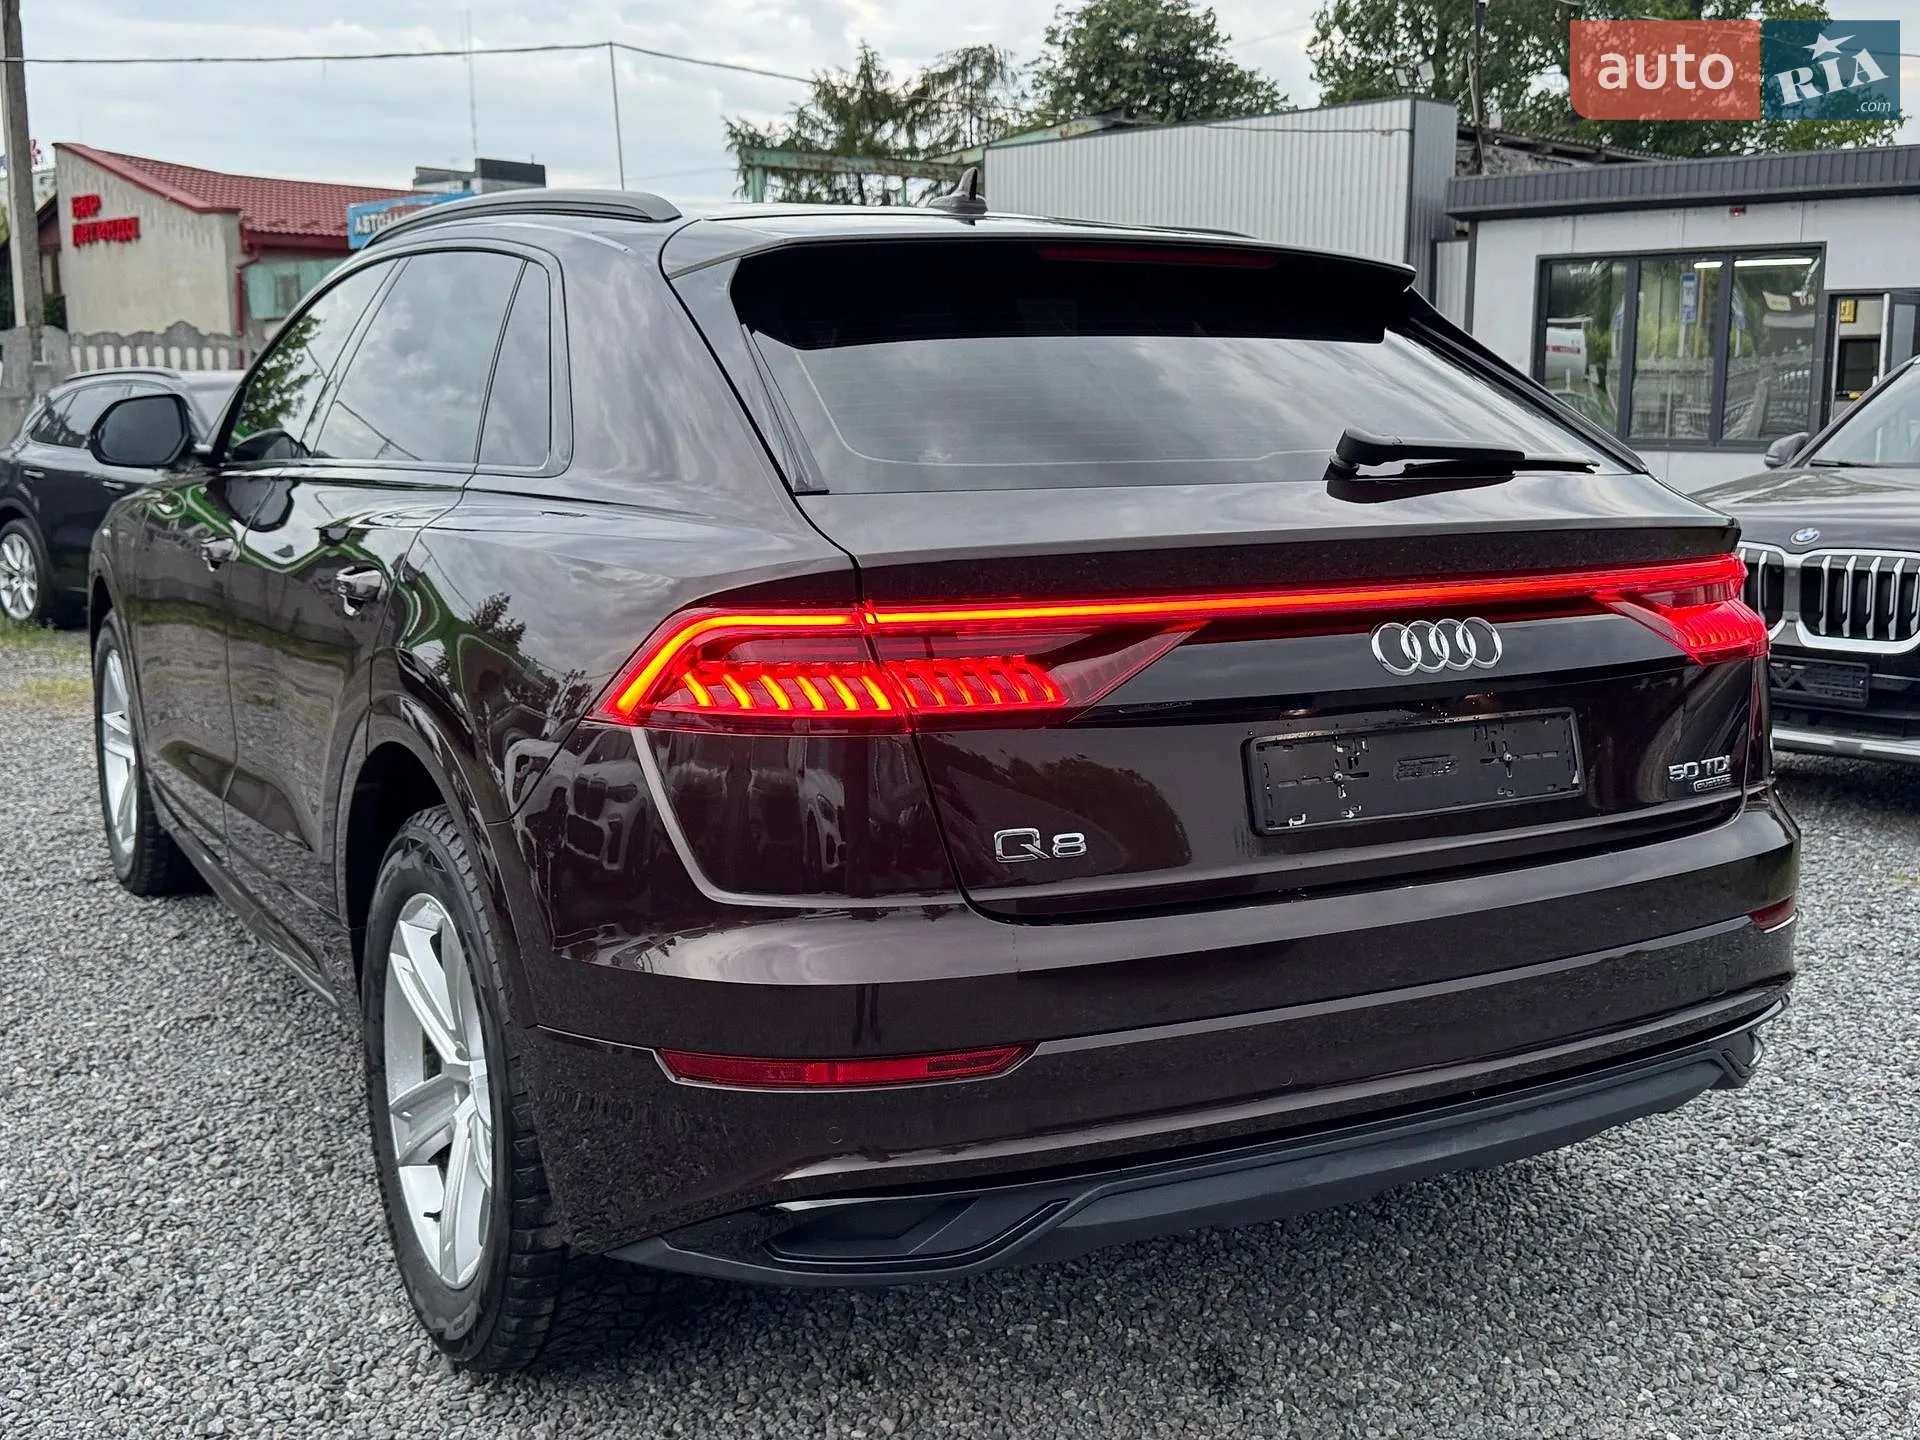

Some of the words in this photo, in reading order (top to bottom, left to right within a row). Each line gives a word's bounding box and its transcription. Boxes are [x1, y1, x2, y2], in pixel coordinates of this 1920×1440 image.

[1668, 762, 1699, 781] 50
[1701, 755, 1731, 776] TDI
[993, 827, 1087, 863] Q8
